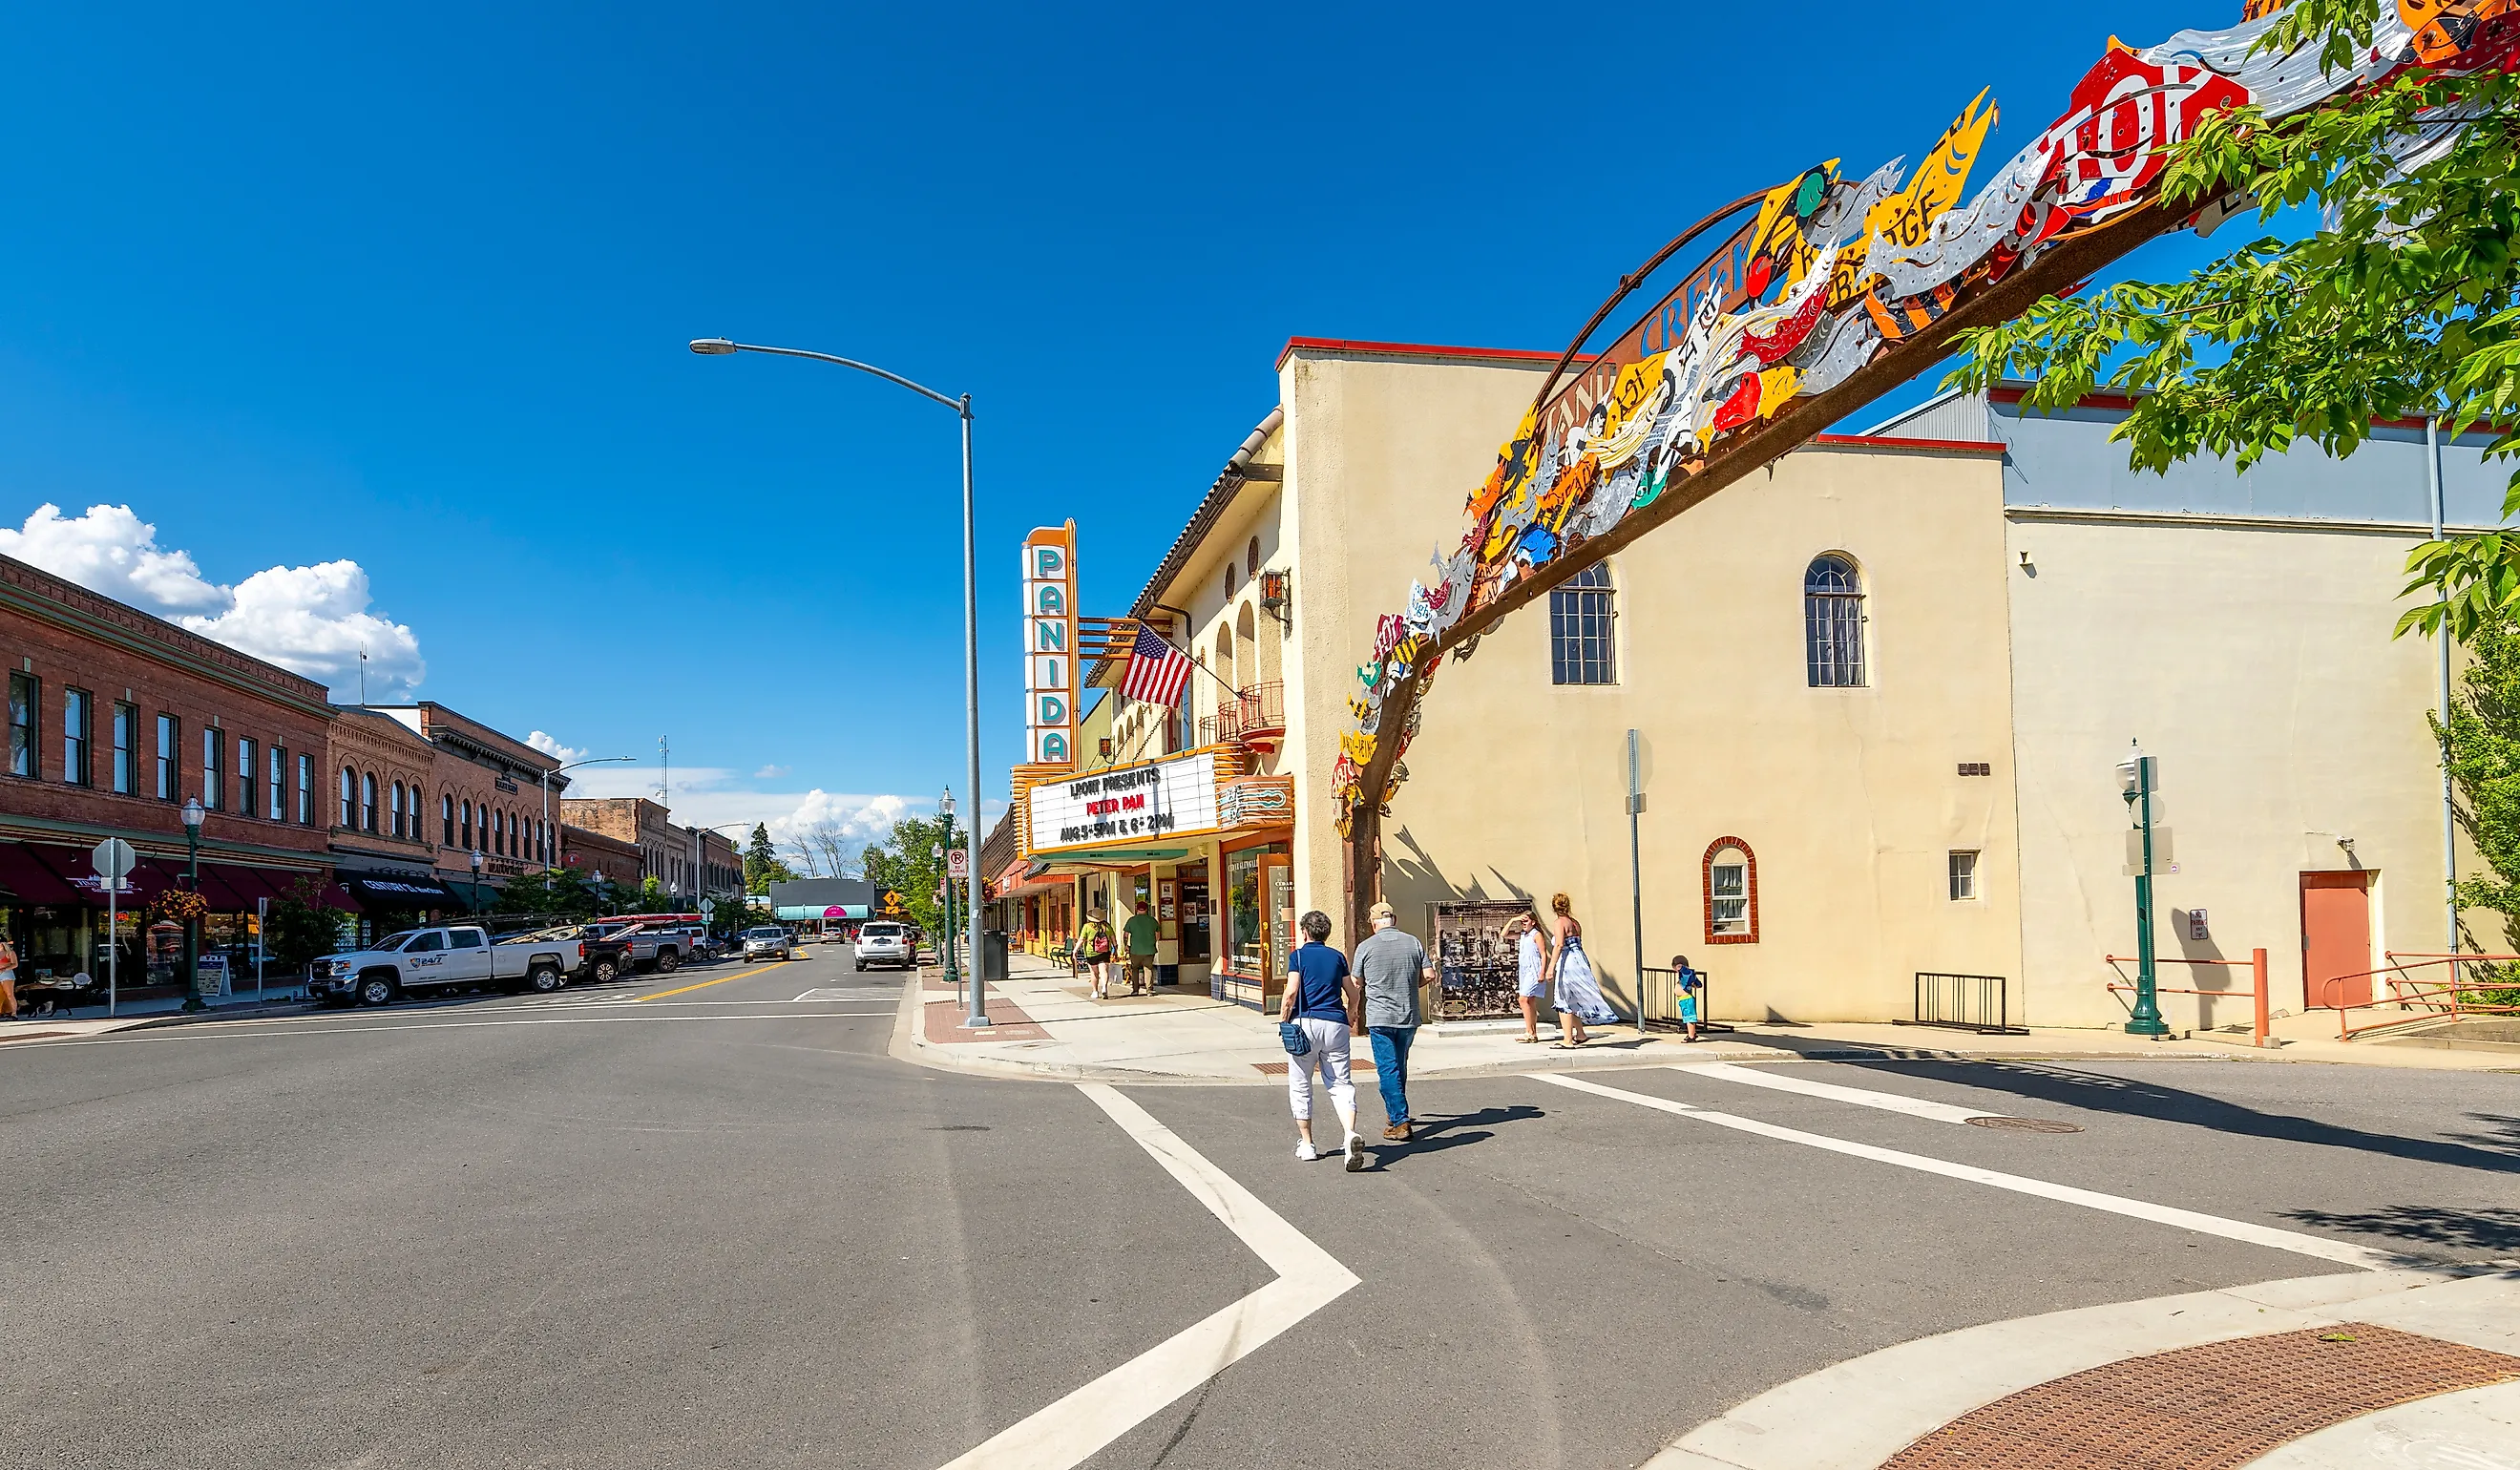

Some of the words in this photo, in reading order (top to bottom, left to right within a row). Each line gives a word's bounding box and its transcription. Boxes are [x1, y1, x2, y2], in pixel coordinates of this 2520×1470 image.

[1835, 188, 1936, 301] BRDGE
[1038, 549, 1067, 761] PANIDA
[1086, 798, 1120, 816] PETER
[1123, 793, 1144, 811] PAN
[1102, 766, 1161, 791] PRESENTS
